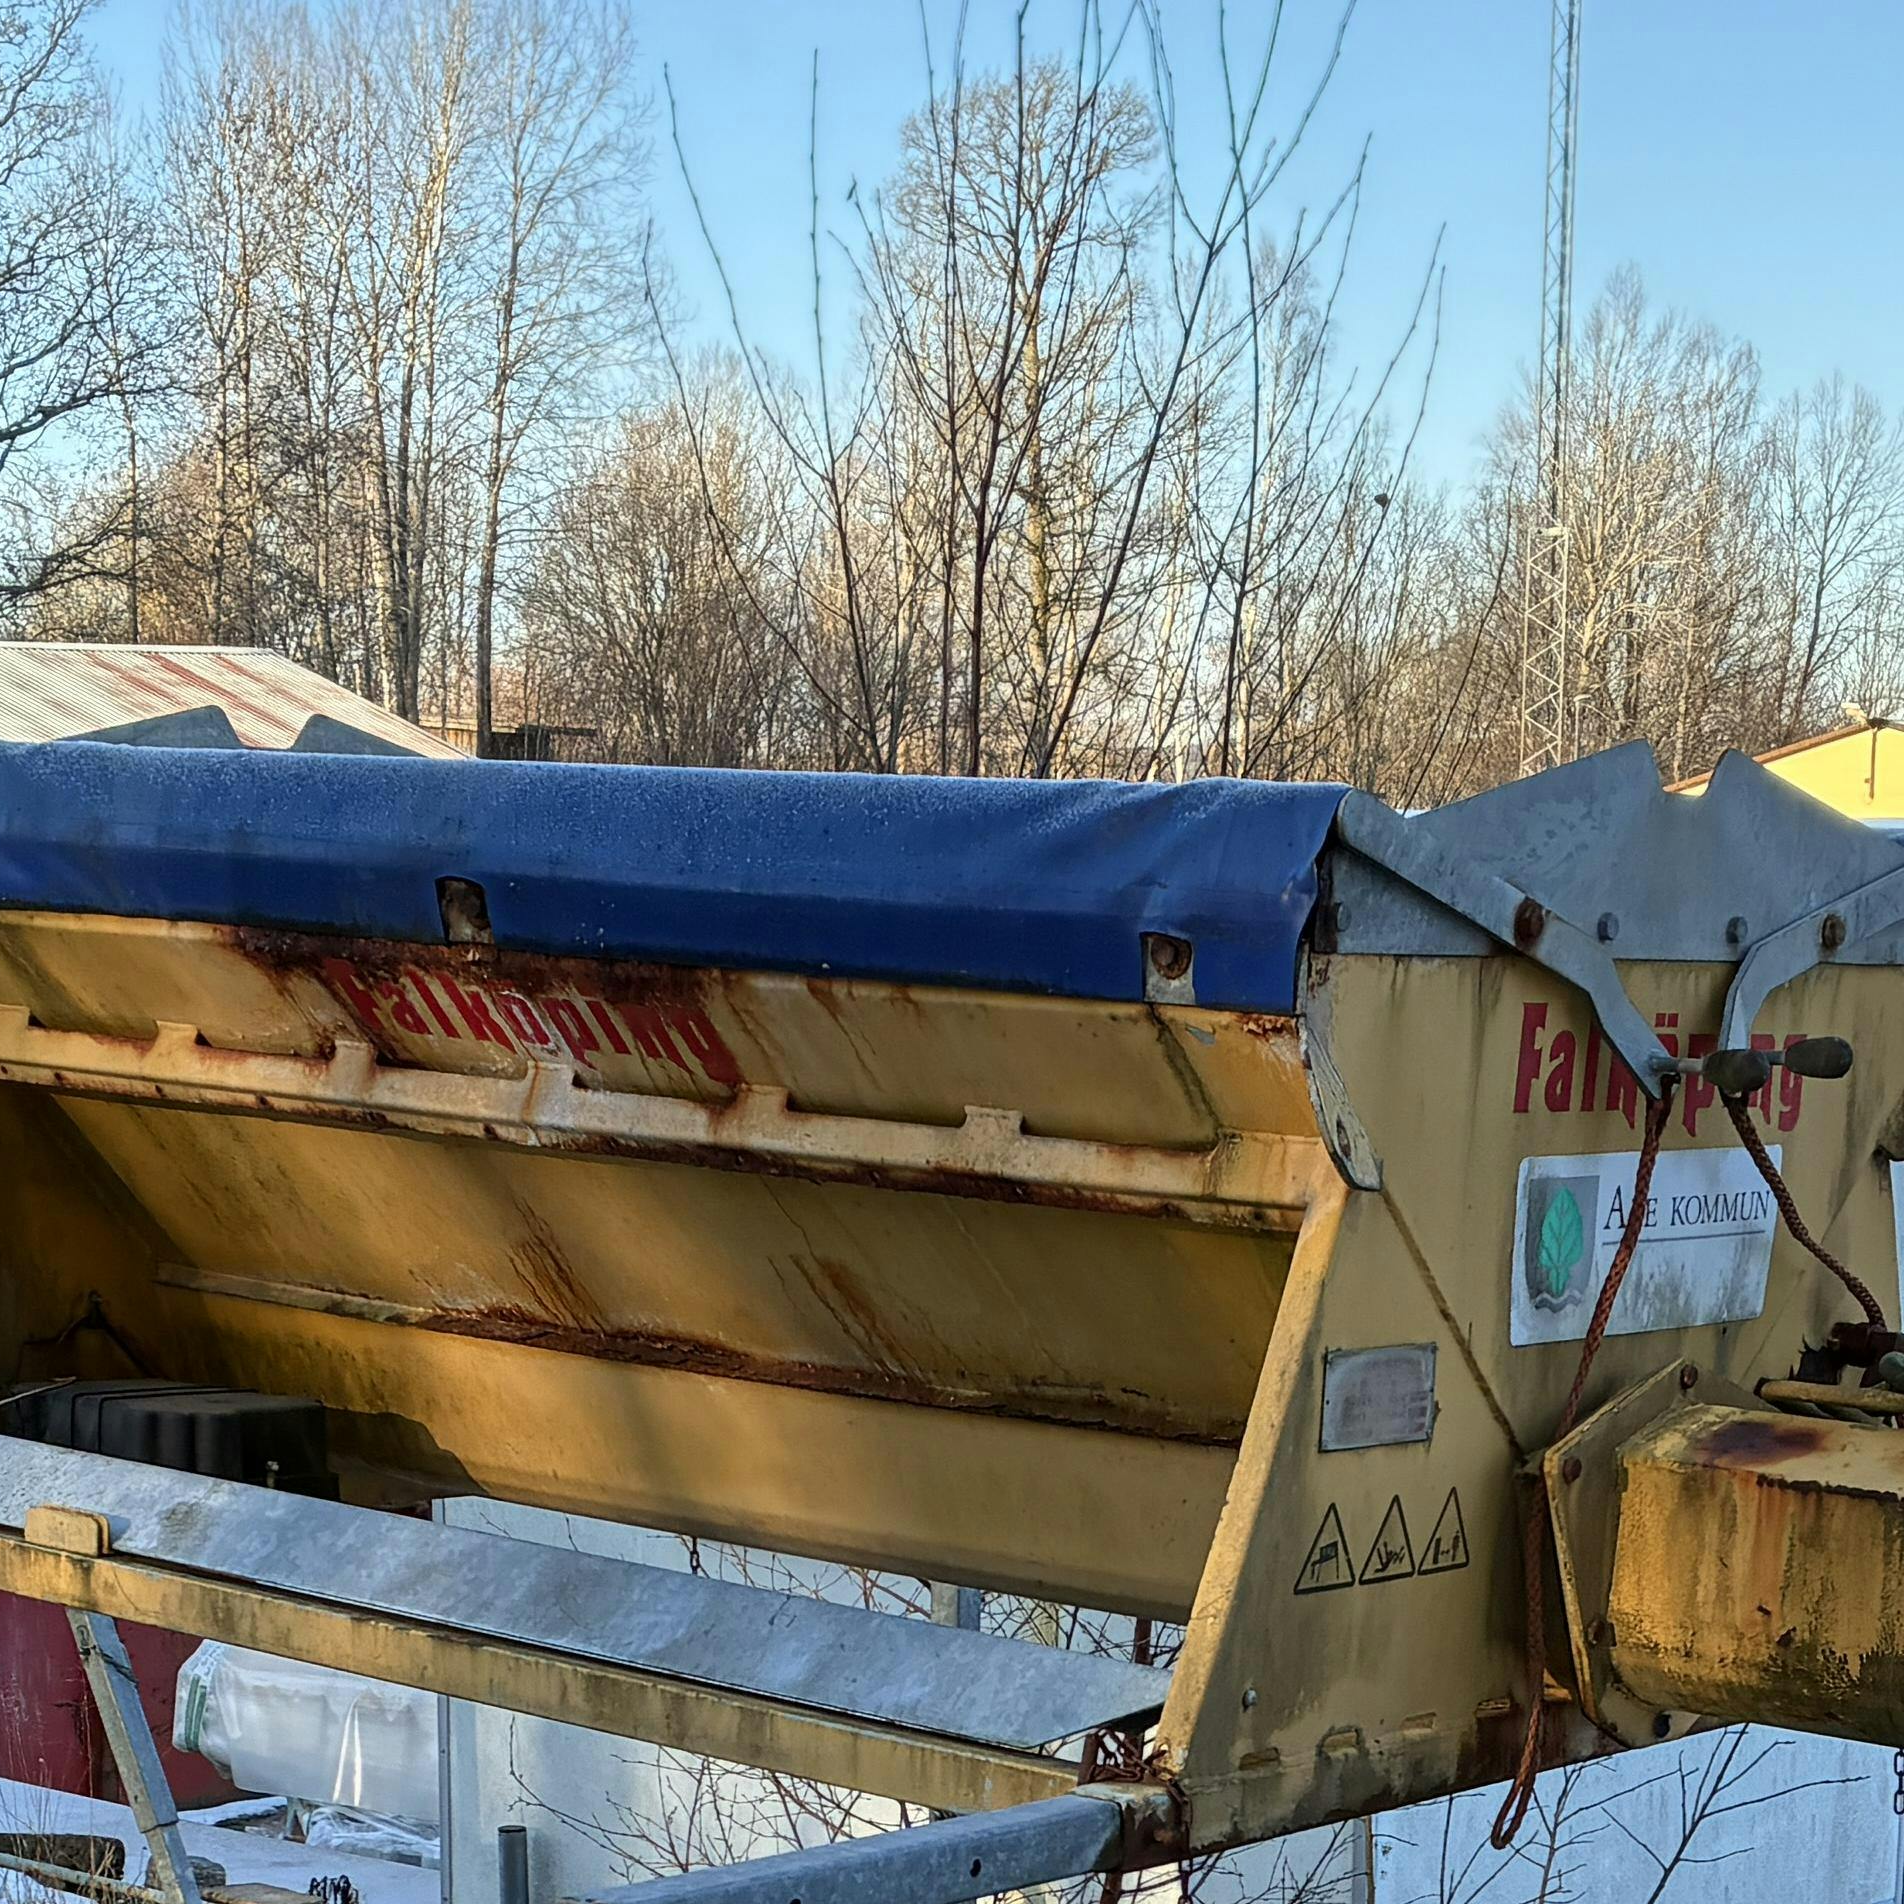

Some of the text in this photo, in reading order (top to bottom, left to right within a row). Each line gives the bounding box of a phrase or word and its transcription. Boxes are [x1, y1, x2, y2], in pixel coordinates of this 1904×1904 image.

[1512, 1002, 1809, 1138] Falkpng
[1603, 1184, 1771, 1230] AE KOMMUN
